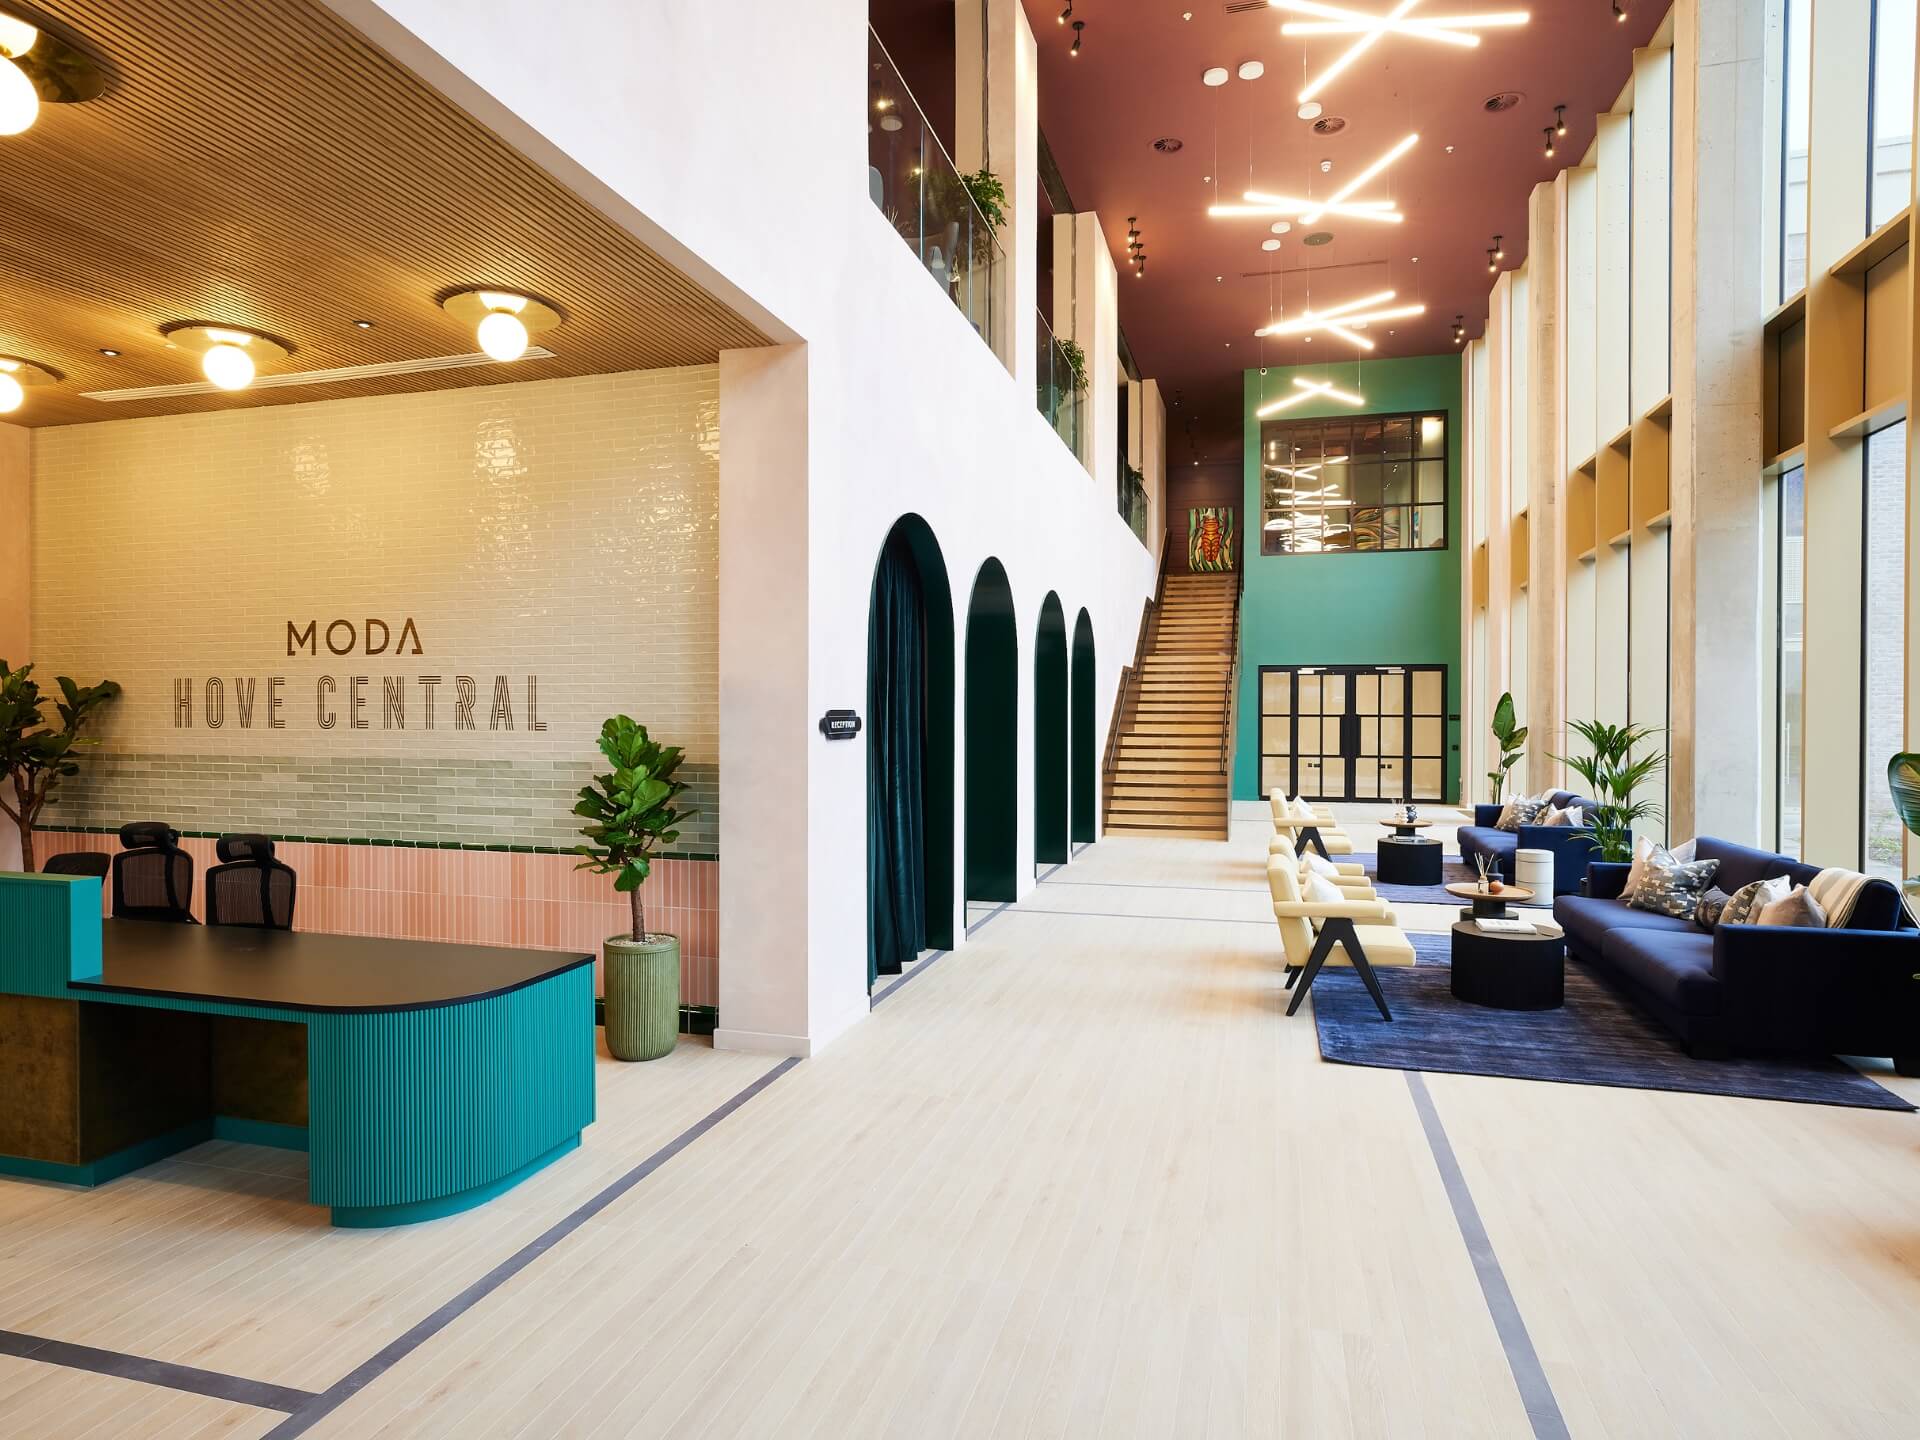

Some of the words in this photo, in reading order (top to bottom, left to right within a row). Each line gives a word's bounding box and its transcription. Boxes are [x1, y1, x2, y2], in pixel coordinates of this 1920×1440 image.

[287, 617, 424, 656] MODA
[174, 676, 286, 729] HOVE
[317, 675, 548, 731] CENTRAL
